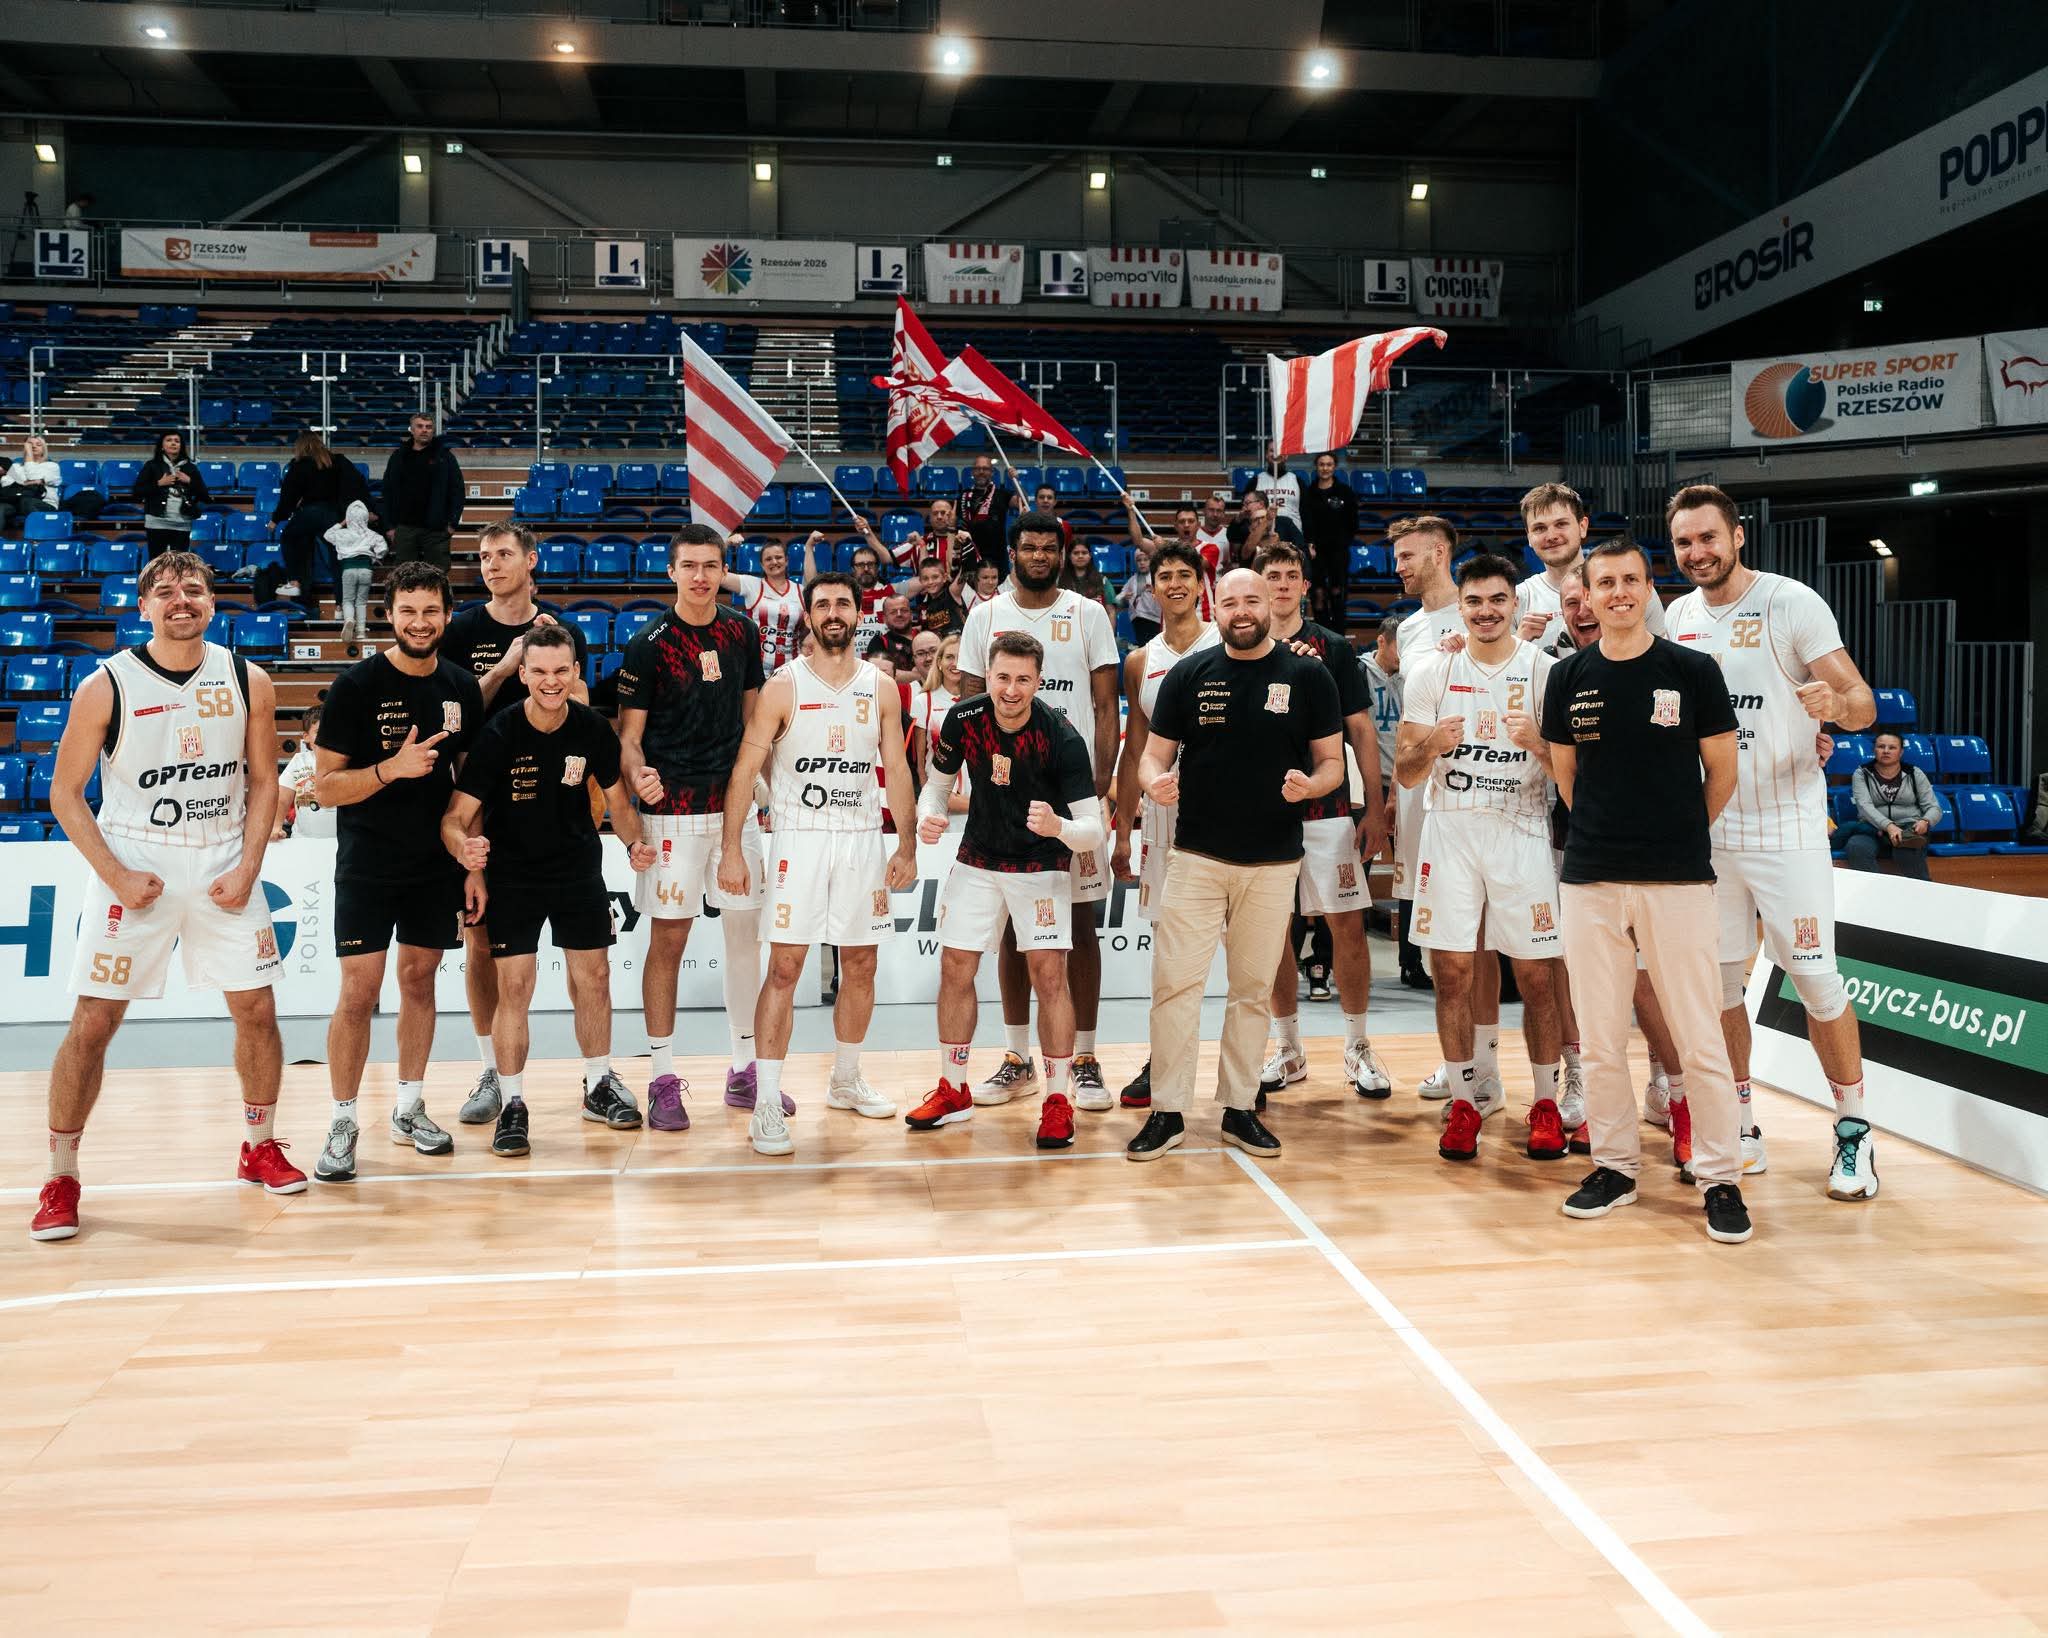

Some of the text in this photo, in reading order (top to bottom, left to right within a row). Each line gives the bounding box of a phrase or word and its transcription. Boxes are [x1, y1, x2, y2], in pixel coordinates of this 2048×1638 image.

[761, 257, 827, 268] Rzeszów 2026
[1809, 352, 1959, 382] SUPER SPORT
[1837, 376, 1945, 397] Polskie Radio
[1837, 393, 1945, 417] RZESZÓW
[1050, 620, 1072, 643] 10
[1729, 619, 1763, 649] 32
[199, 680, 226, 688] CUTLINE
[1197, 690, 1231, 698] OPTeam
[196, 688, 234, 719] 58
[1507, 683, 1525, 711] 2
[1569, 701, 1605, 712] OPTeam
[855, 699, 870, 725] 3
[957, 706, 985, 720] CUTLINE
[138, 759, 238, 789] OPTeam
[794, 757, 871, 775] OPTeam
[186, 808, 230, 822] Polska
[656, 879, 685, 906] 44
[300, 880, 322, 976] POLSKA
[774, 903, 792, 929] 3
[1416, 907, 1433, 935] 2
[1531, 935, 1559, 944] CUTLINE
[90, 952, 133, 987] 58
[1792, 953, 1823, 961] CUTLINE
[1841, 973, 2026, 1048] ozycz-bus.pl
